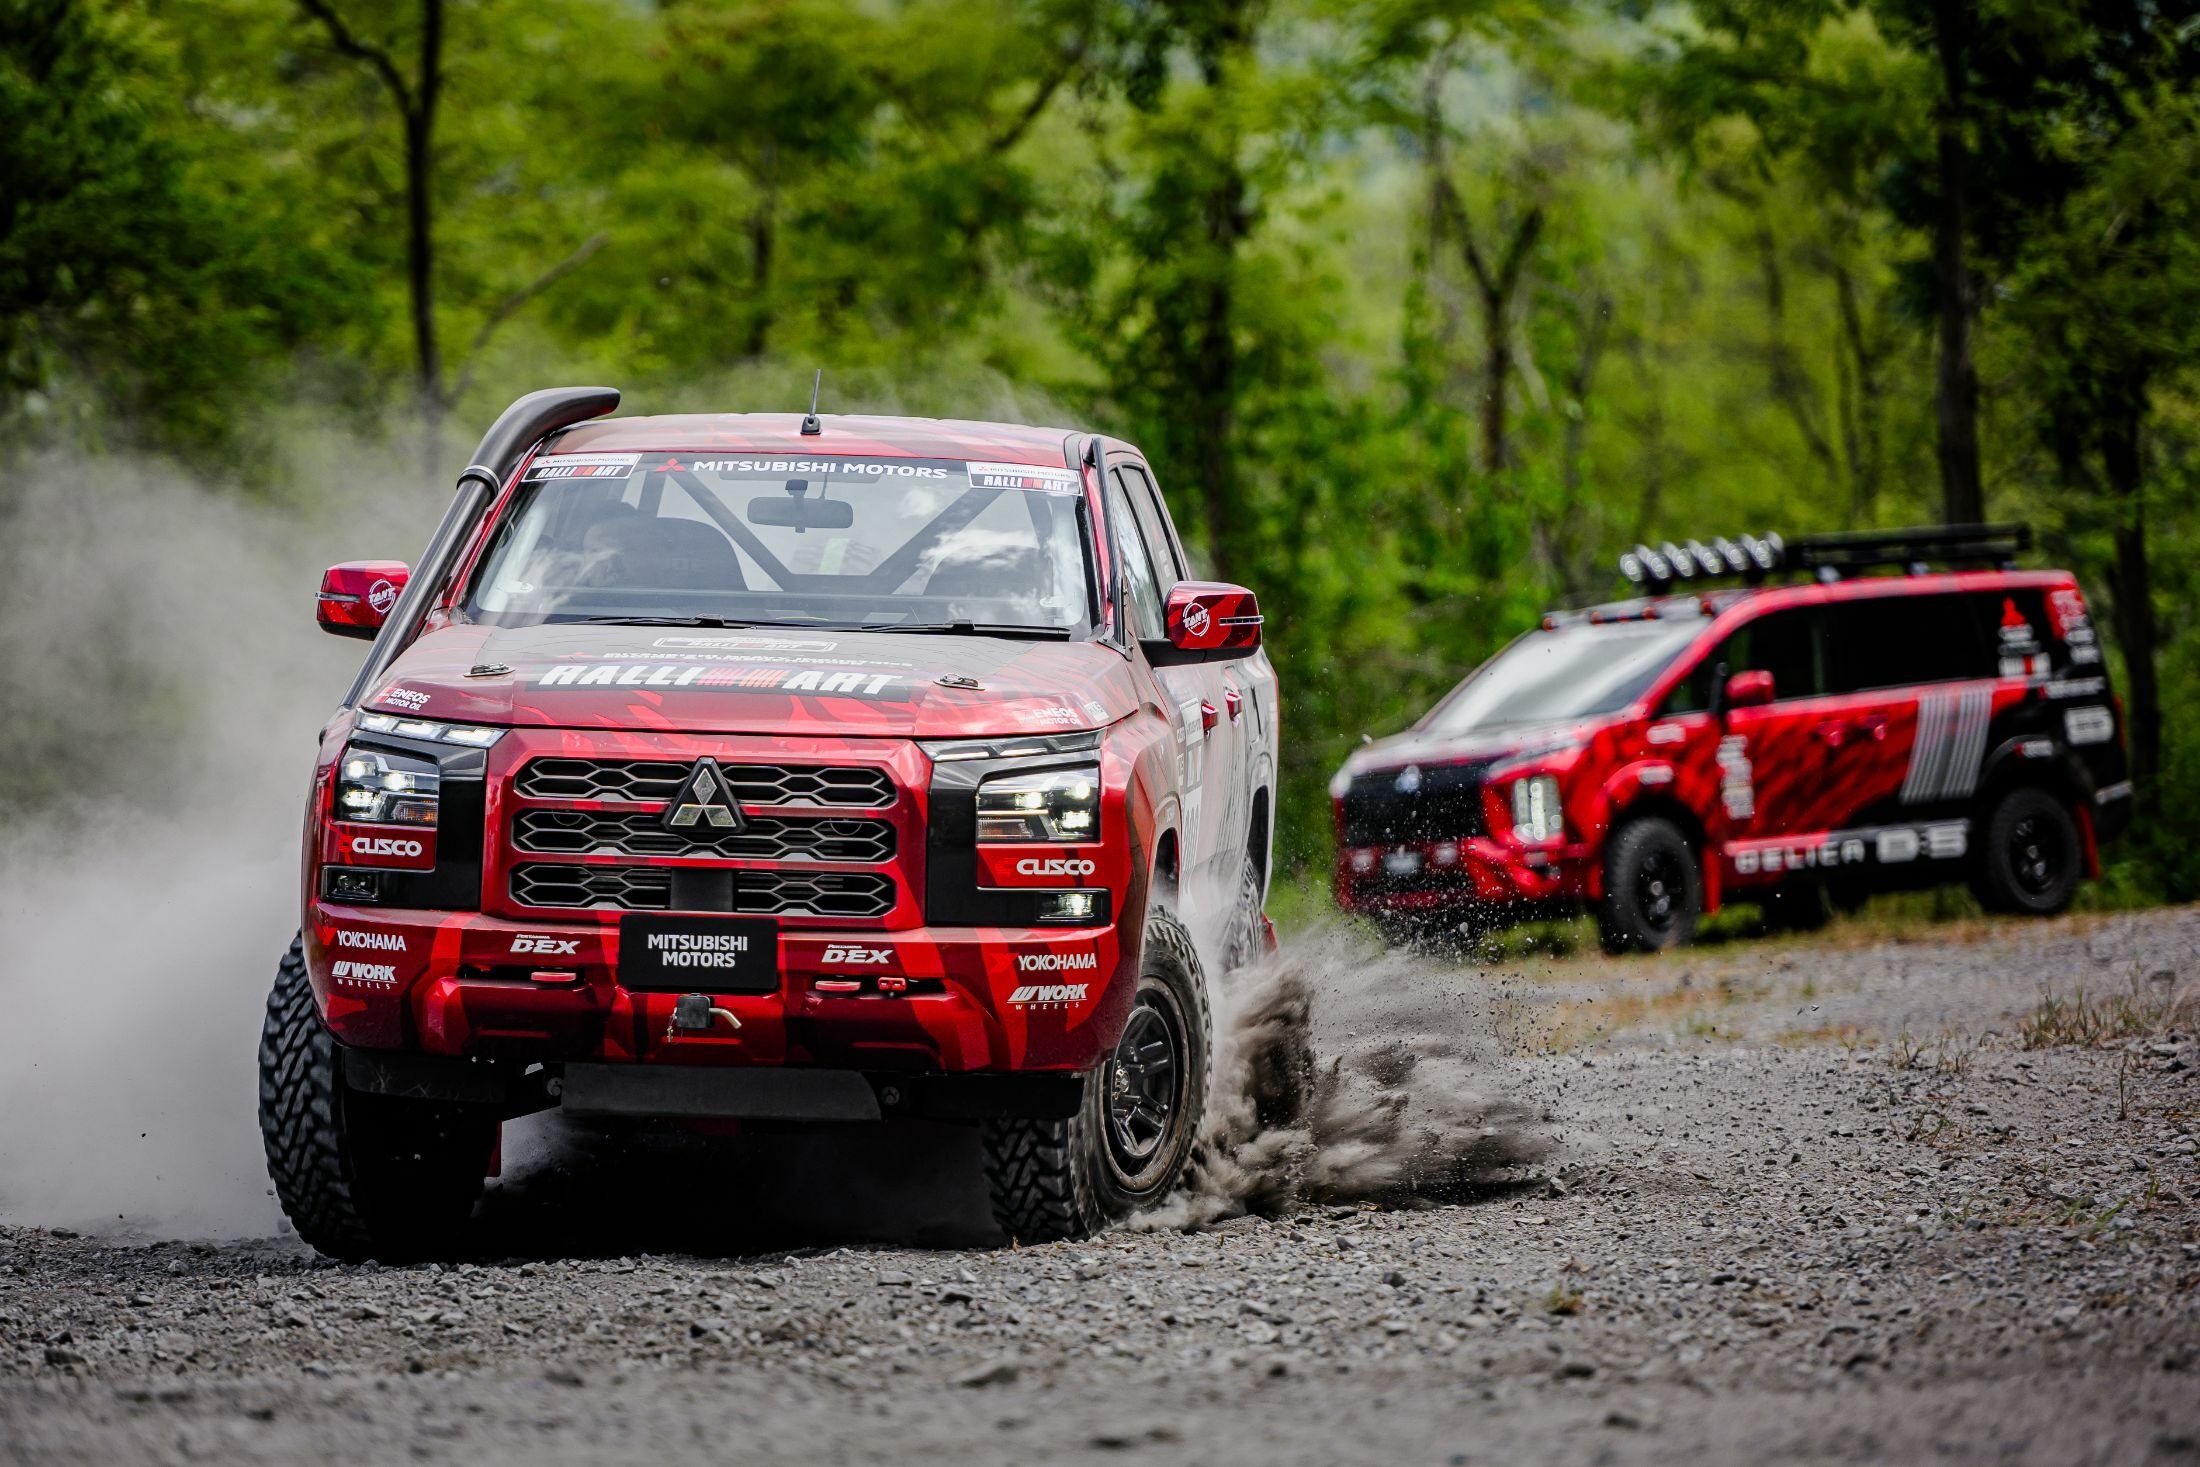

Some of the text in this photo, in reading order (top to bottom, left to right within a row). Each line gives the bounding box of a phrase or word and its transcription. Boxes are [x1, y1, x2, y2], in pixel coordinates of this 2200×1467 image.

[693, 460, 948, 479] MITSUBISHI MOTORS
[983, 475, 1070, 491] RALLI ART
[538, 665, 903, 694] RALLI ART
[384, 697, 421, 711] MOTOR OIL
[391, 688, 431, 704] ENEOS
[351, 837, 422, 857] CUSCO
[1016, 858, 1095, 876] CUSCO
[337, 930, 406, 951] YOKOHAMA
[510, 938, 580, 954] DEX
[647, 934, 748, 951] MITSUBISHI
[662, 951, 736, 968] MOTORS
[821, 949, 894, 964] DEX
[1018, 953, 1097, 971] YOKOHAMA
[351, 962, 396, 982] WORK
[337, 978, 391, 990] WHEELS
[1037, 983, 1089, 1001] WORK
[1015, 1001, 1080, 1010] WHEELS
